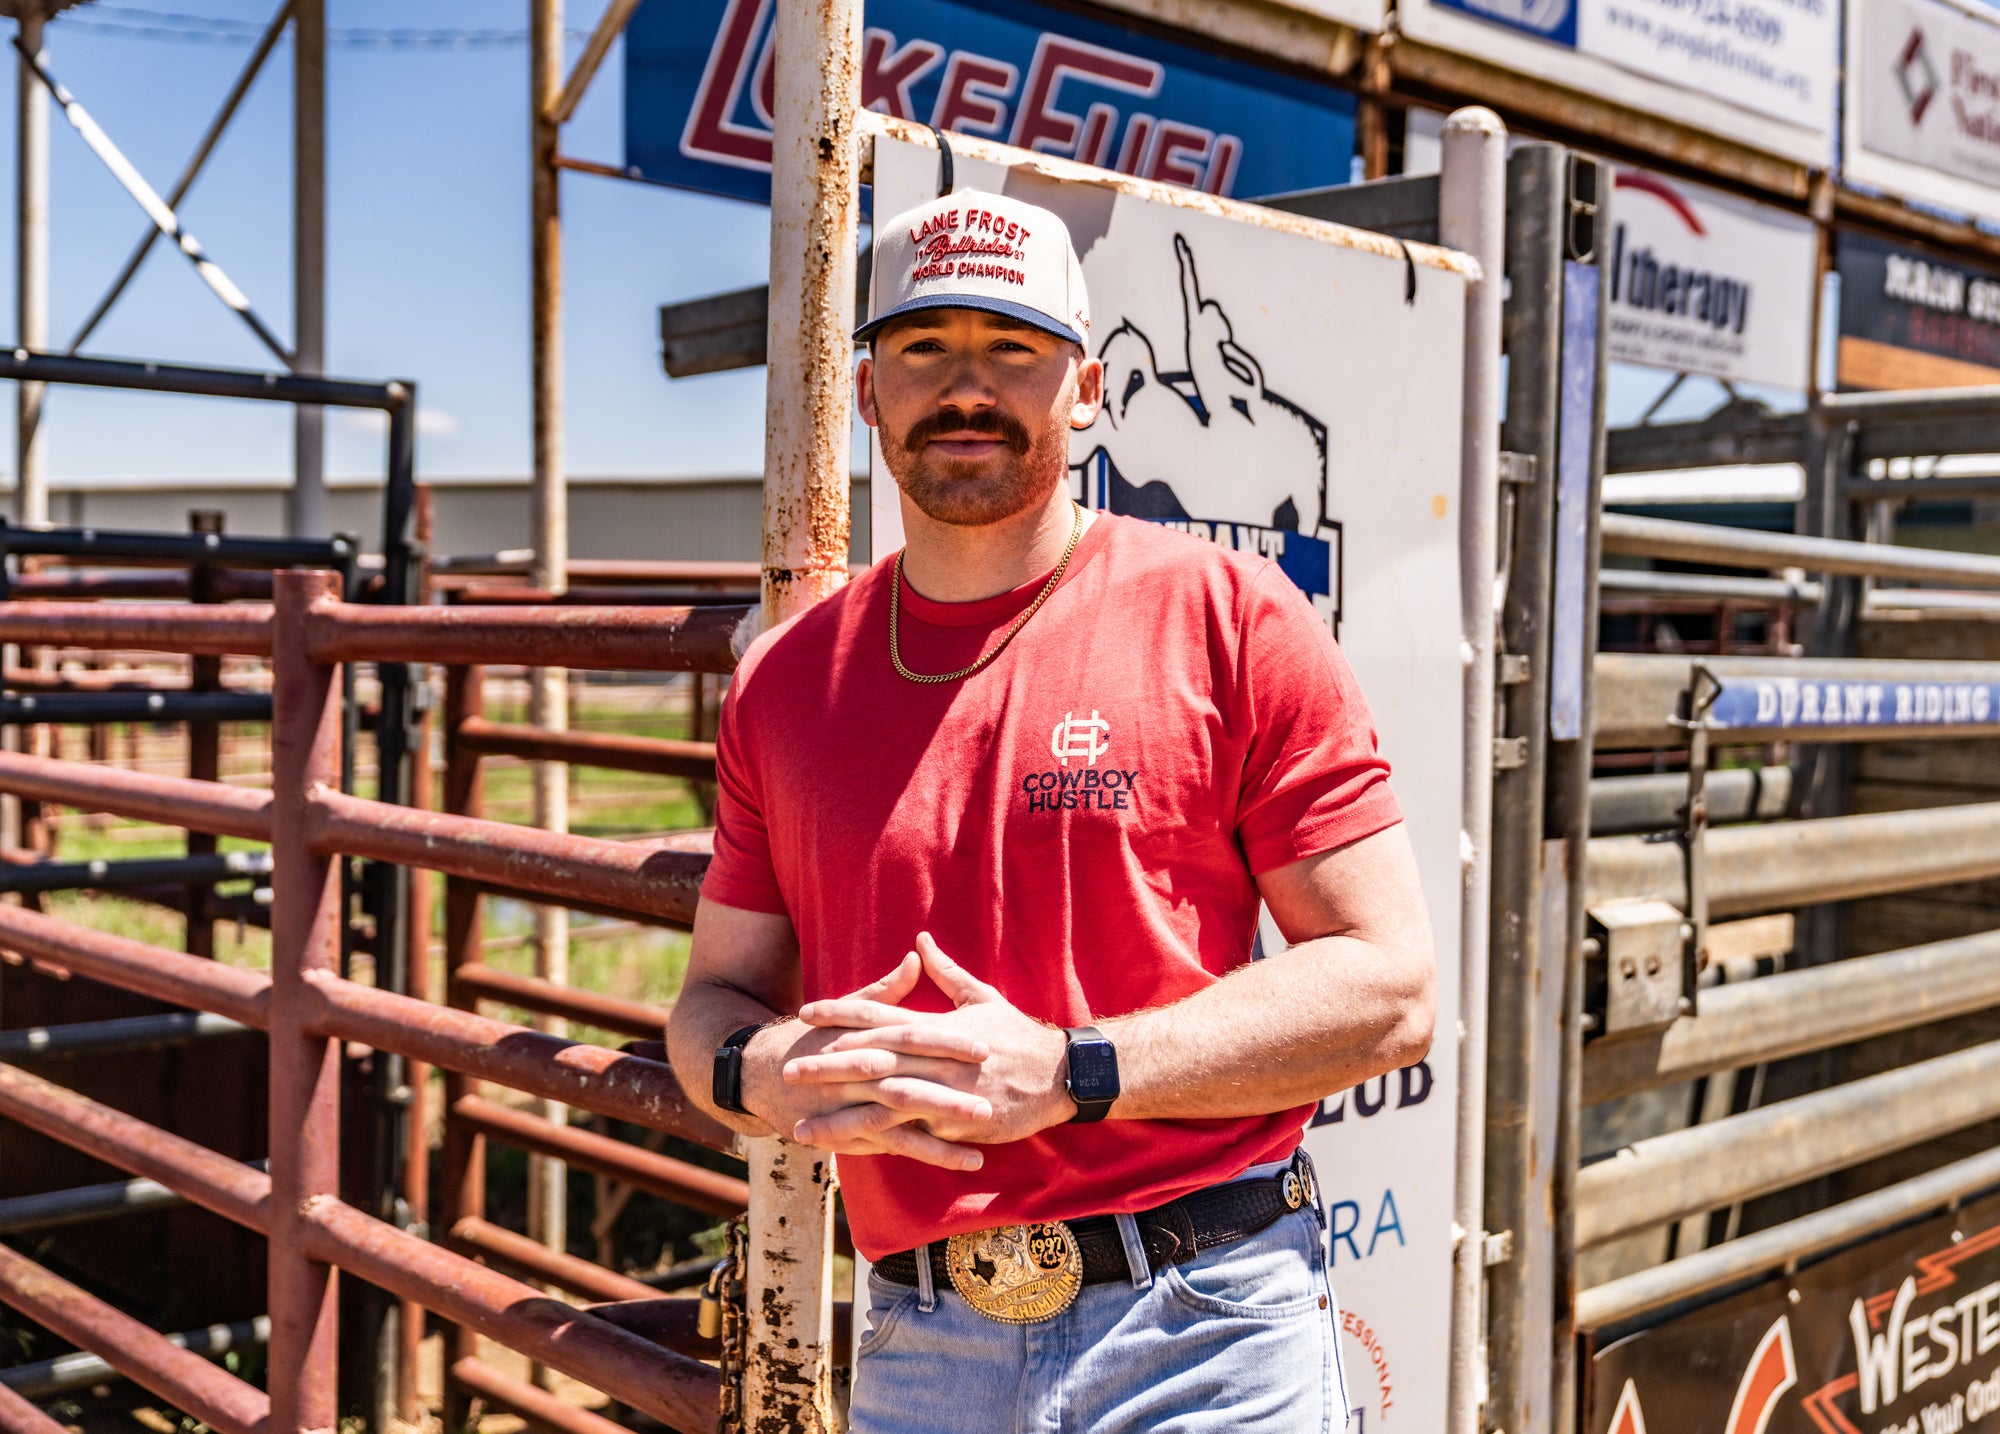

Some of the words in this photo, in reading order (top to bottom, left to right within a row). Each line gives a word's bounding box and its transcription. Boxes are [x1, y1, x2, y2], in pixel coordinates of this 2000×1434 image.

[910, 209, 959, 244] LANE
[966, 209, 1031, 247] FROST
[925, 233, 1014, 262] Bullrider
[912, 261, 955, 282] WORLD
[958, 261, 1026, 286] CHAMPION
[1628, 245, 1749, 335] therapy
[1756, 683, 1884, 726] DURANT
[1895, 685, 1991, 722] RIDING
[1022, 769, 1139, 793] COWBOY
[1028, 789, 1129, 813] HUSTLE
[1031, 1236, 1062, 1253] 1997
[1007, 1270, 1077, 1319] CHAMPION
[1339, 1309, 1393, 1421] ESSIONAL
